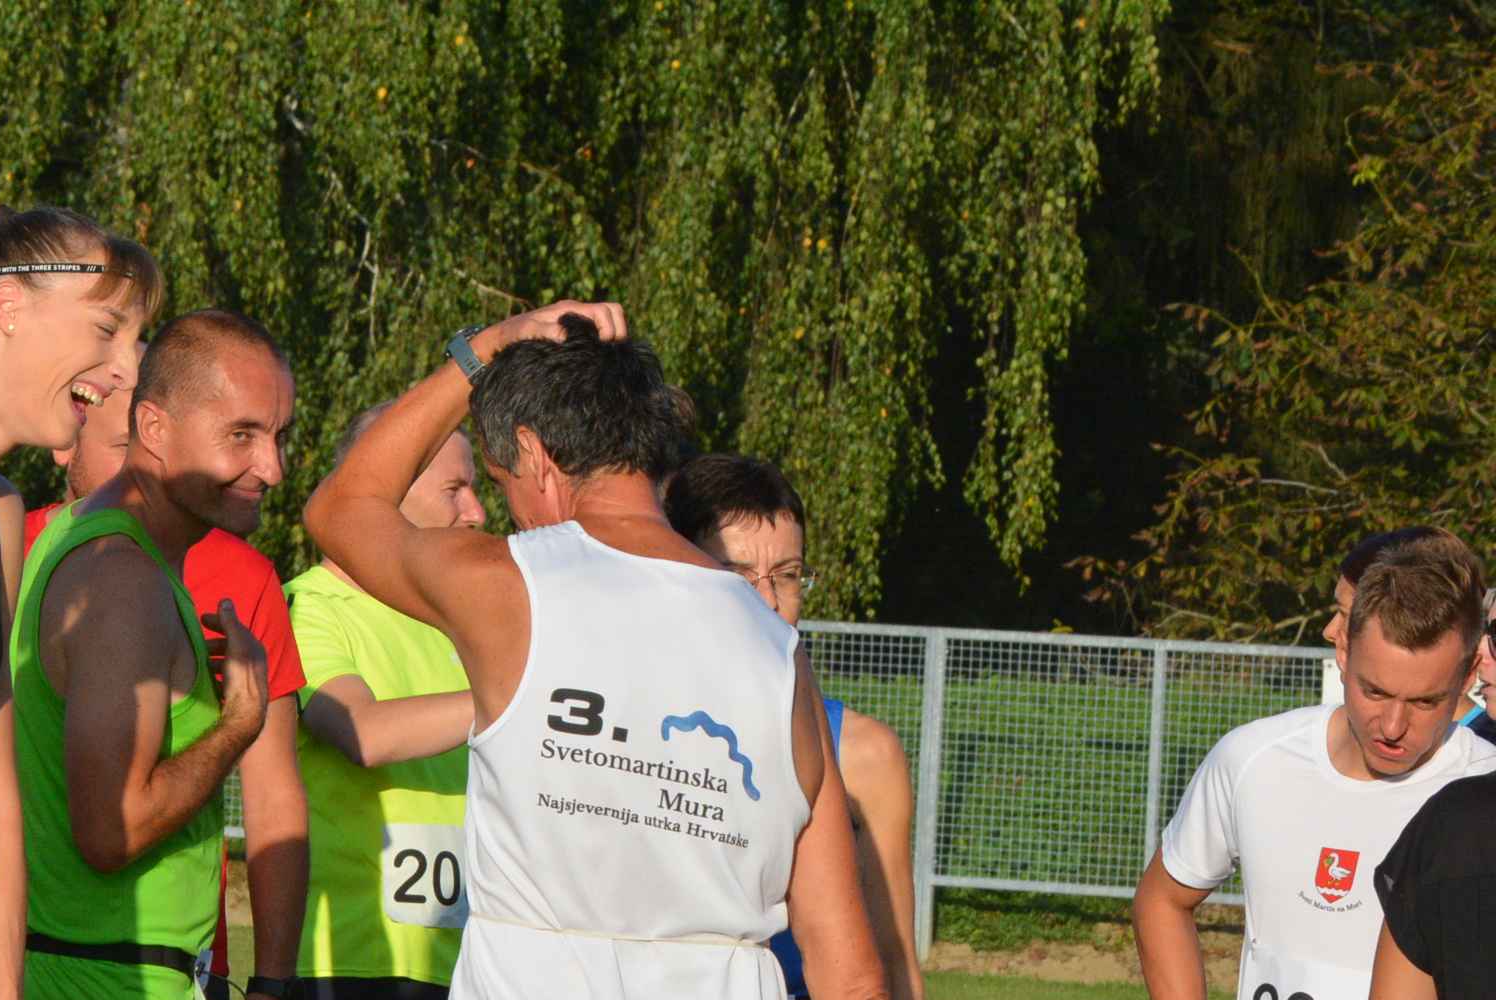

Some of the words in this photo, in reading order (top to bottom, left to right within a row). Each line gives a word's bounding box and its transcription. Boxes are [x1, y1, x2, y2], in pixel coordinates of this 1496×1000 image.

[547, 687, 629, 743] 3.
[539, 738, 729, 794] Svetomartinska
[536, 793, 640, 826] Najsjevernija
[643, 814, 682, 833] utrka
[685, 821, 751, 849] Hrvatske
[656, 788, 726, 822] Mura
[393, 848, 461, 906] 20
